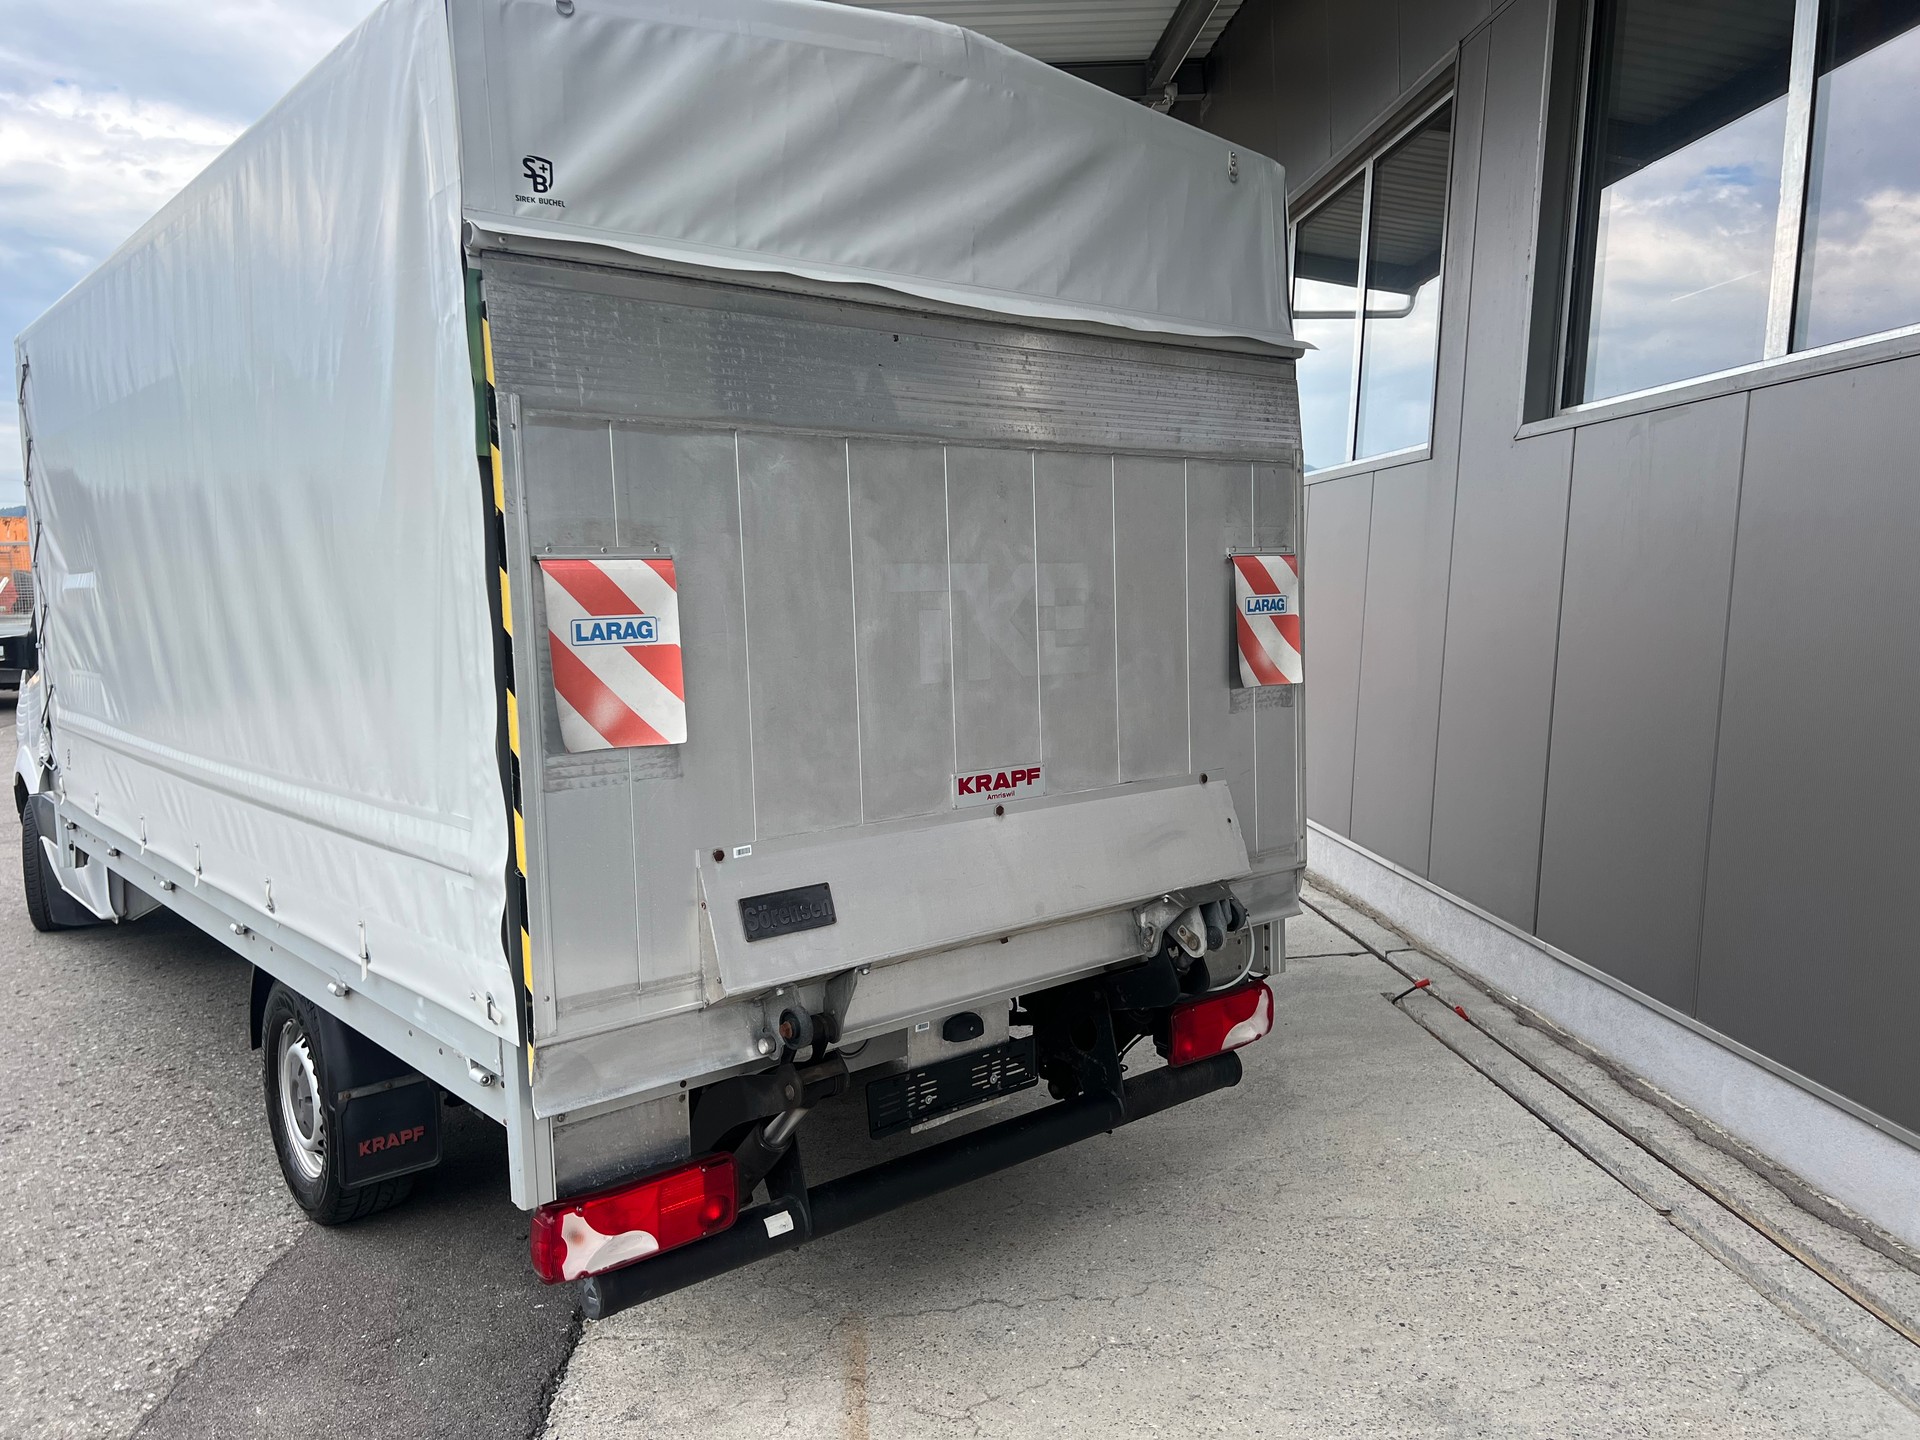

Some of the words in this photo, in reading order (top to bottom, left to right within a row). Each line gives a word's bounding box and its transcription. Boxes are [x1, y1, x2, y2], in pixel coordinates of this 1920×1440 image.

[515, 194, 536, 204] SIREK
[1247, 598, 1285, 613] LARAG
[575, 621, 653, 642] LARAG
[958, 767, 1040, 795] KRAPF
[986, 790, 1016, 801] Amriswil
[744, 899, 833, 932] Sörensen
[359, 1125, 425, 1157] KRAPF
